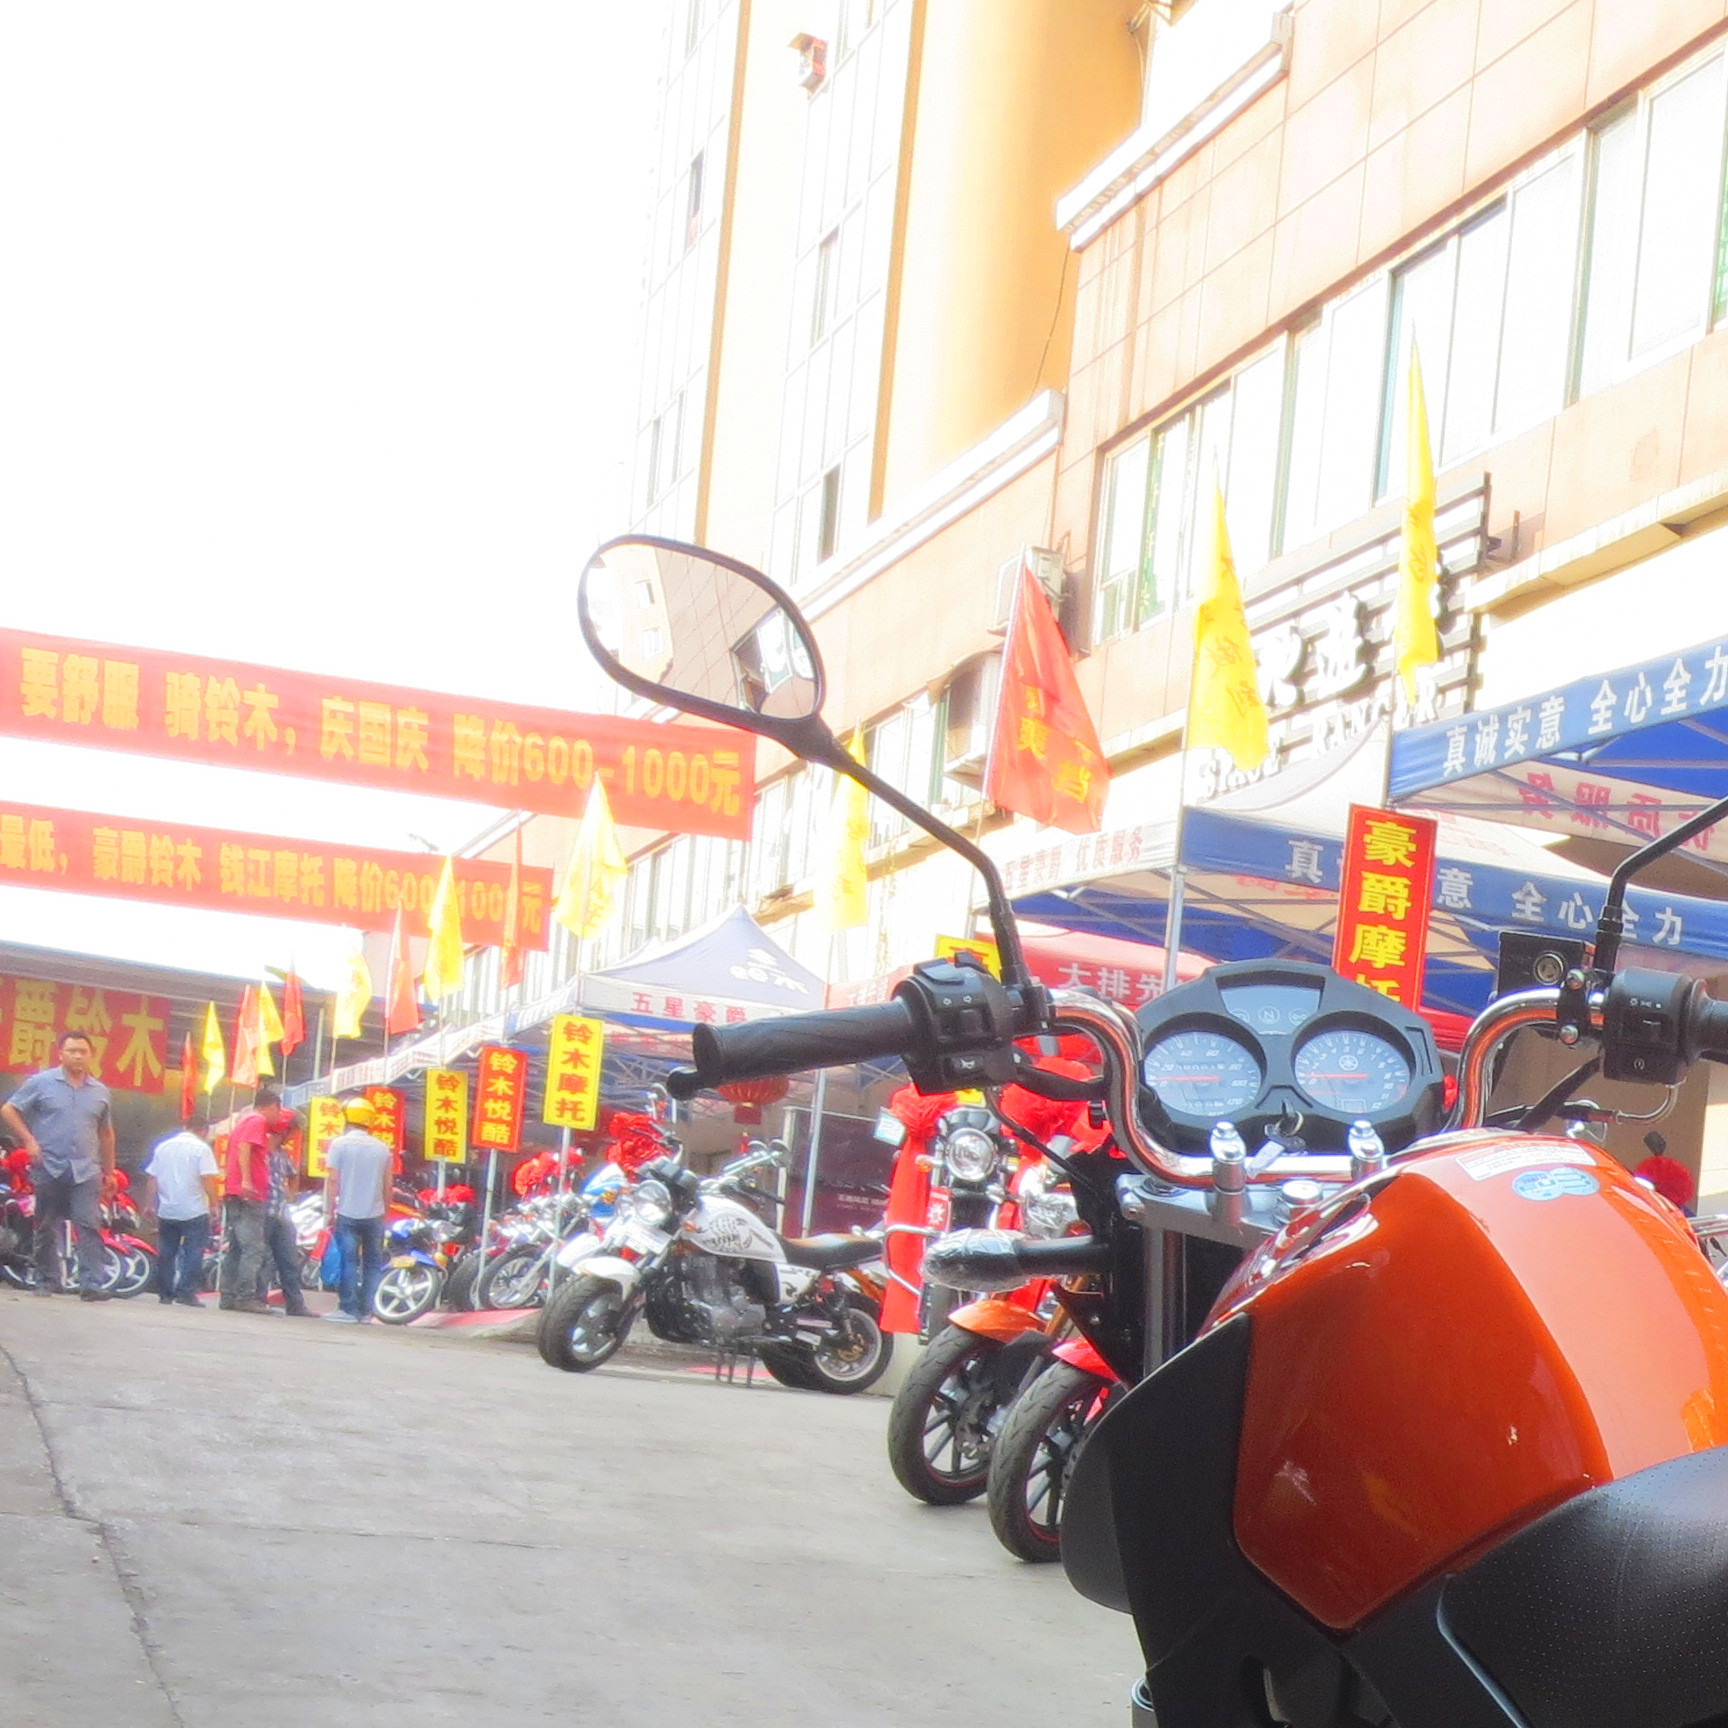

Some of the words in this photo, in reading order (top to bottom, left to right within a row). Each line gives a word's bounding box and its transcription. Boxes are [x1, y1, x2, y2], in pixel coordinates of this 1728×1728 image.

[20, 646, 140, 731] 要舒服
[320, 695, 429, 773] 庆国庆
[1443, 695, 1565, 777] 真诚实意
[93, 827, 202, 892] 豪爵铃木
[219, 842, 325, 907] 钱江摩托
[1284, 839, 1473, 910] 真意
[0, 977, 164, 1087] 爵铃木
[555, 1021, 594, 1122] 铃木摩托
[434, 1073, 460, 1157] 铃木悦酷
[481, 1051, 518, 1145] 铃木悦酷
